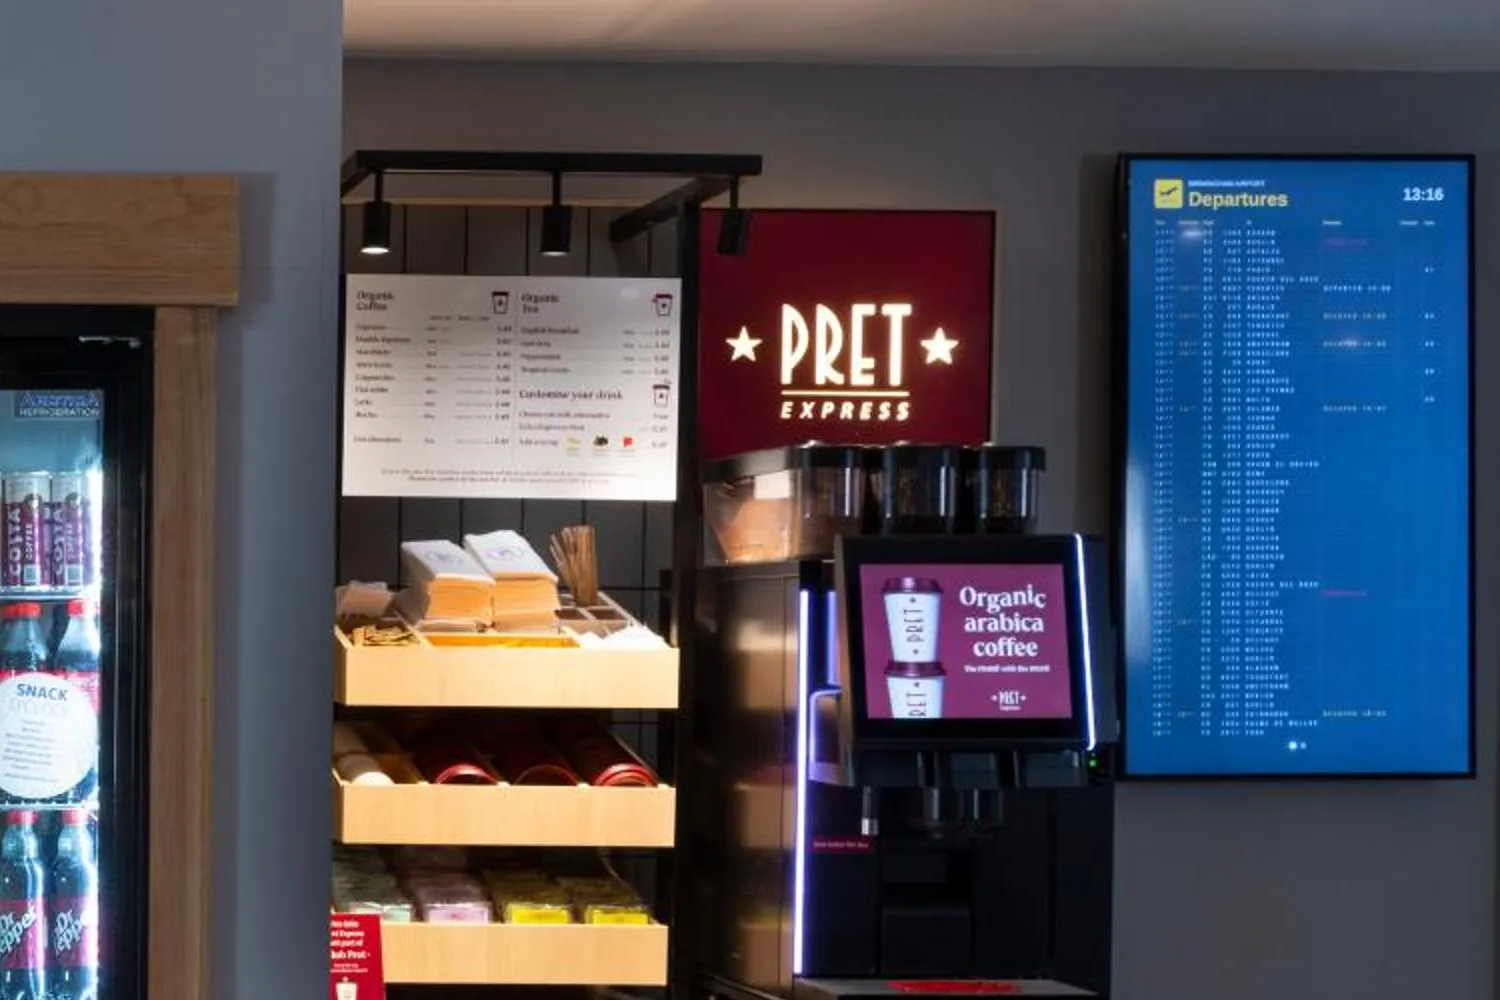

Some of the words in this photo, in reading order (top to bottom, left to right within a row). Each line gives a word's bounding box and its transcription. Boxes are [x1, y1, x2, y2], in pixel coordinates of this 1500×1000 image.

[1188, 191, 1288, 211] Departures
[1403, 187, 1444, 201] 13:16
[781, 303, 913, 387] PRET
[781, 401, 912, 421] EXPRESS
[8, 507, 23, 576] COSTA
[54, 508, 66, 576] COSTA
[959, 584, 1047, 613] Organic
[964, 613, 1044, 633] arabica
[973, 637, 1039, 657] coffee
[16, 683, 68, 701] SNACK
